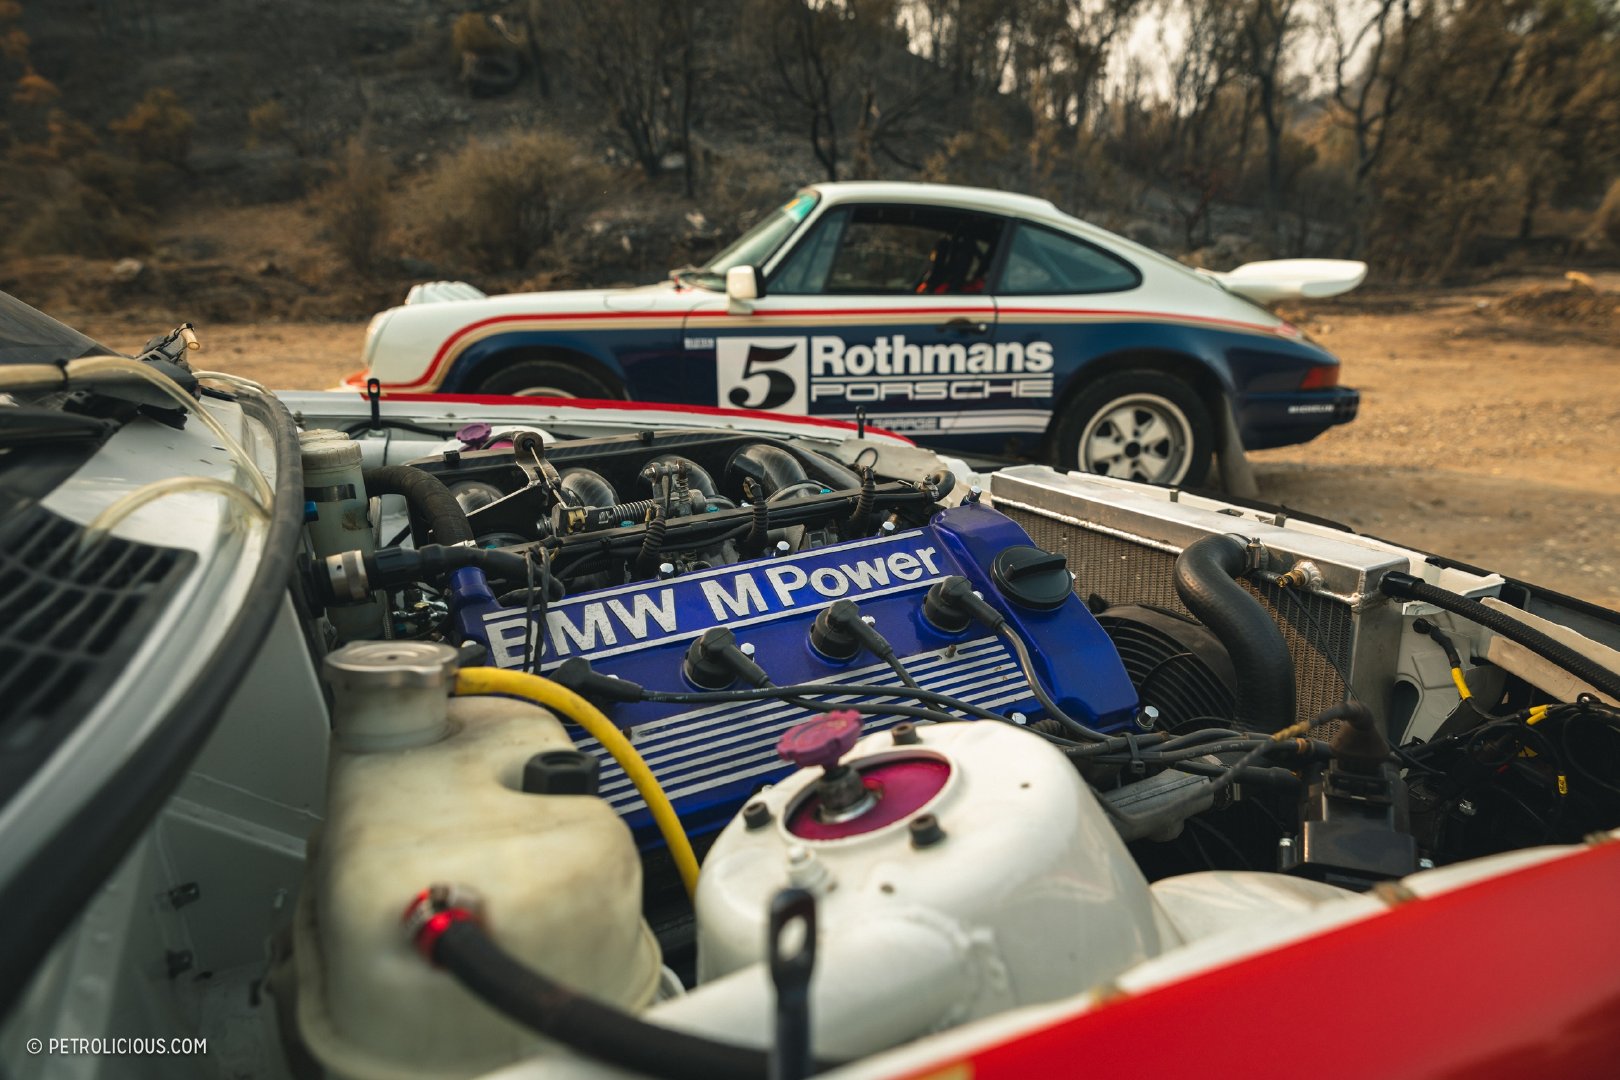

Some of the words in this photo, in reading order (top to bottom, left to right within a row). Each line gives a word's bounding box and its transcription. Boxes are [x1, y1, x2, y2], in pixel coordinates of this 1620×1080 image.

[729, 343, 797, 409] 5
[811, 335, 1054, 376] Rothmans
[811, 381, 1053, 402] PORSCHE
[484, 588, 677, 669] BMW
